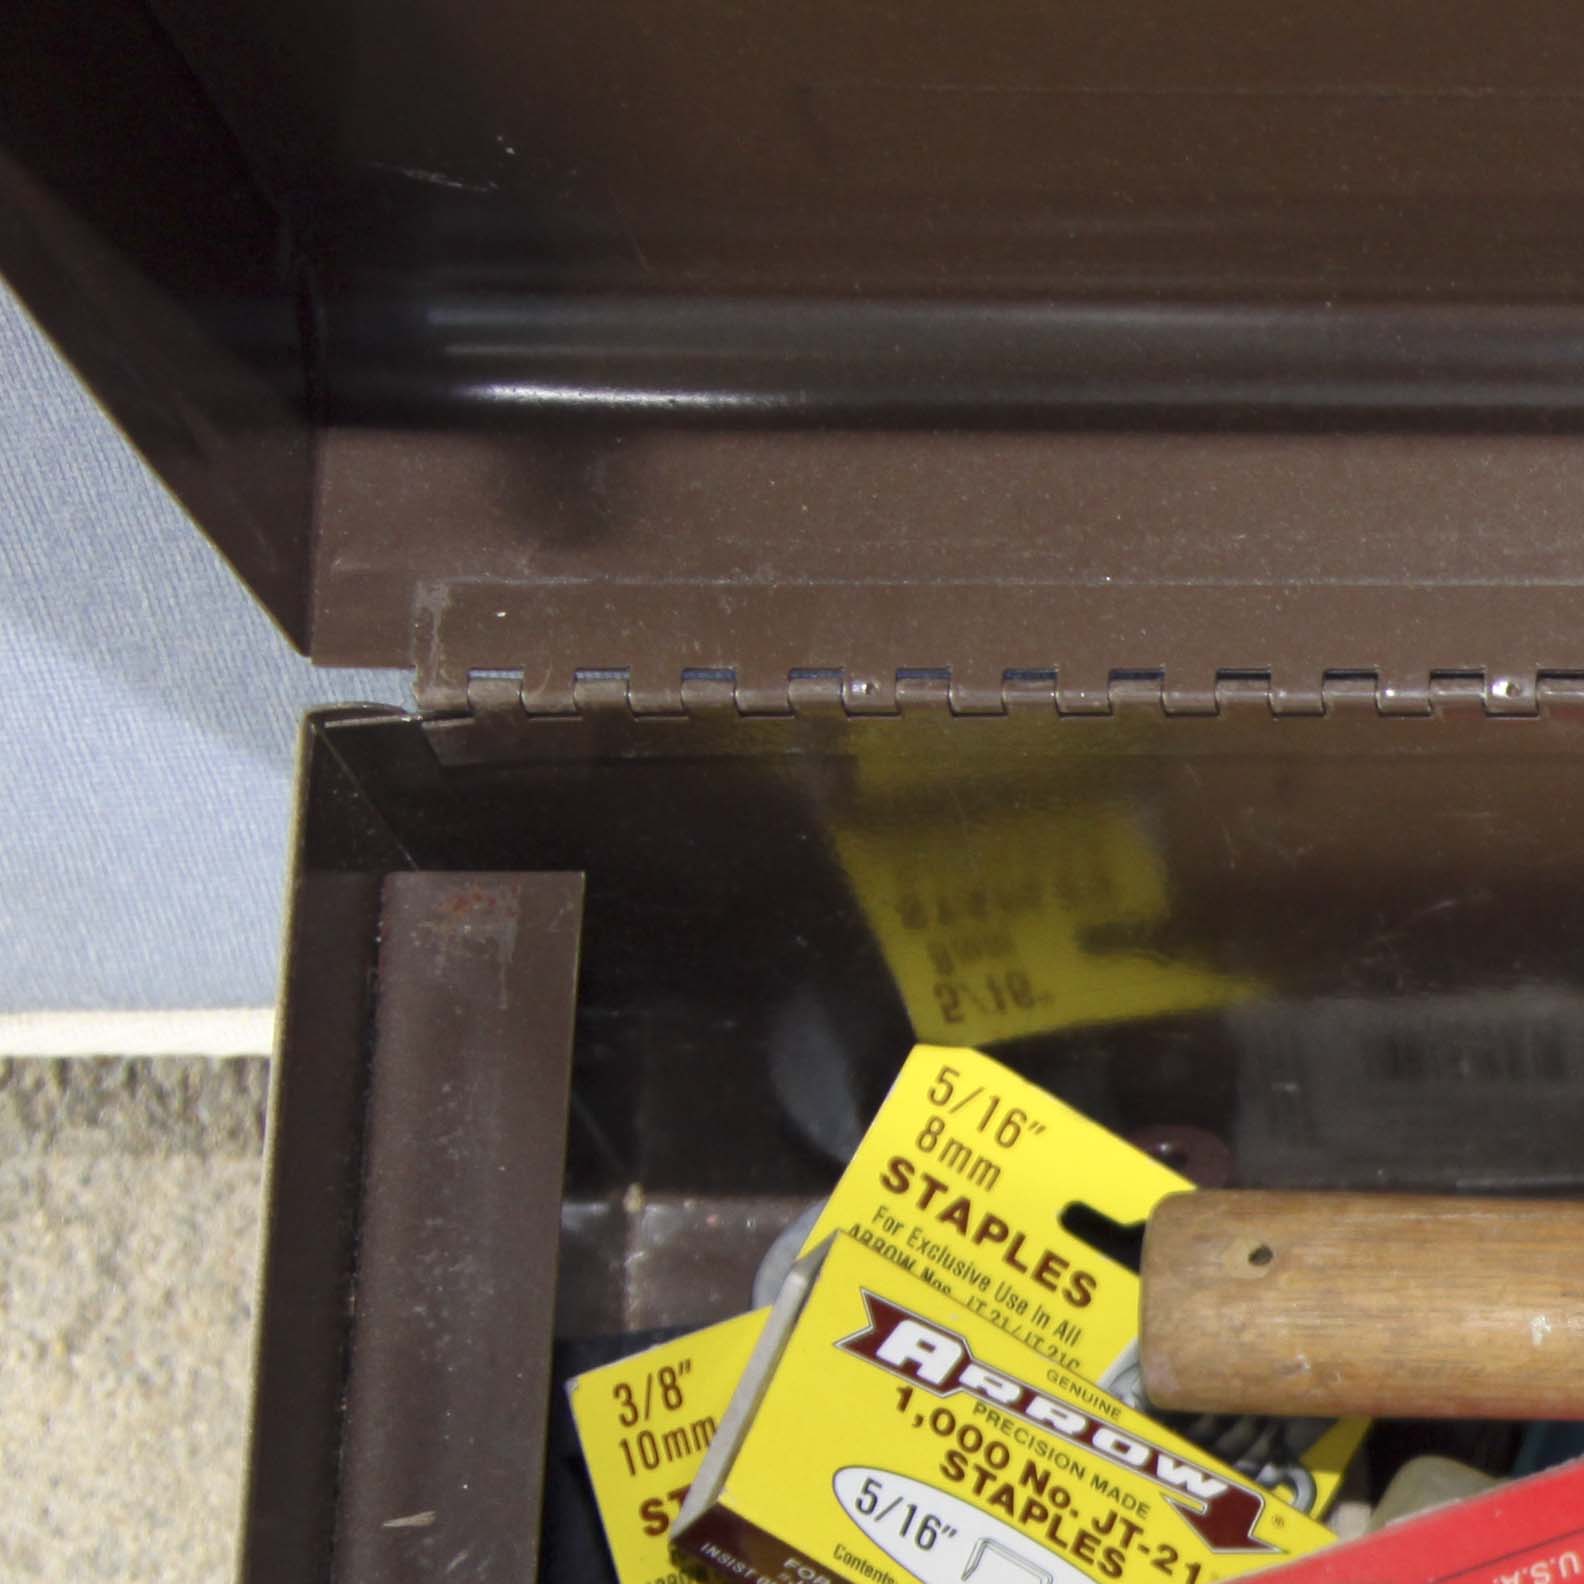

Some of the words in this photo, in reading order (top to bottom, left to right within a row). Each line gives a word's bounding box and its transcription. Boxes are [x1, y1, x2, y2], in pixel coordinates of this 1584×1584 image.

[926, 1065, 1046, 1150] 5/16"
[915, 1115, 1001, 1193] 8mm
[880, 1155, 1098, 1310] STAPLES
[872, 1205, 905, 1236] For
[906, 1226, 991, 1293] Exclusive
[994, 1280, 1028, 1316] Use
[1032, 1303, 1051, 1330] In
[1054, 1317, 1082, 1348] All
[613, 1359, 692, 1428] 3/8"
[876, 1319, 1229, 1499] ARROW
[1046, 1369, 1122, 1420] GENUINE
[619, 1415, 718, 1477] 10mm
[896, 1385, 1010, 1471] 1,000
[1019, 1459, 1078, 1519] No.
[972, 1401, 1086, 1480] PRECISION
[1090, 1472, 1151, 1521] MADE
[855, 1477, 957, 1552] 5/16"
[940, 1448, 1126, 1580] STAPLES
[700, 1542, 757, 1578] INSIST
